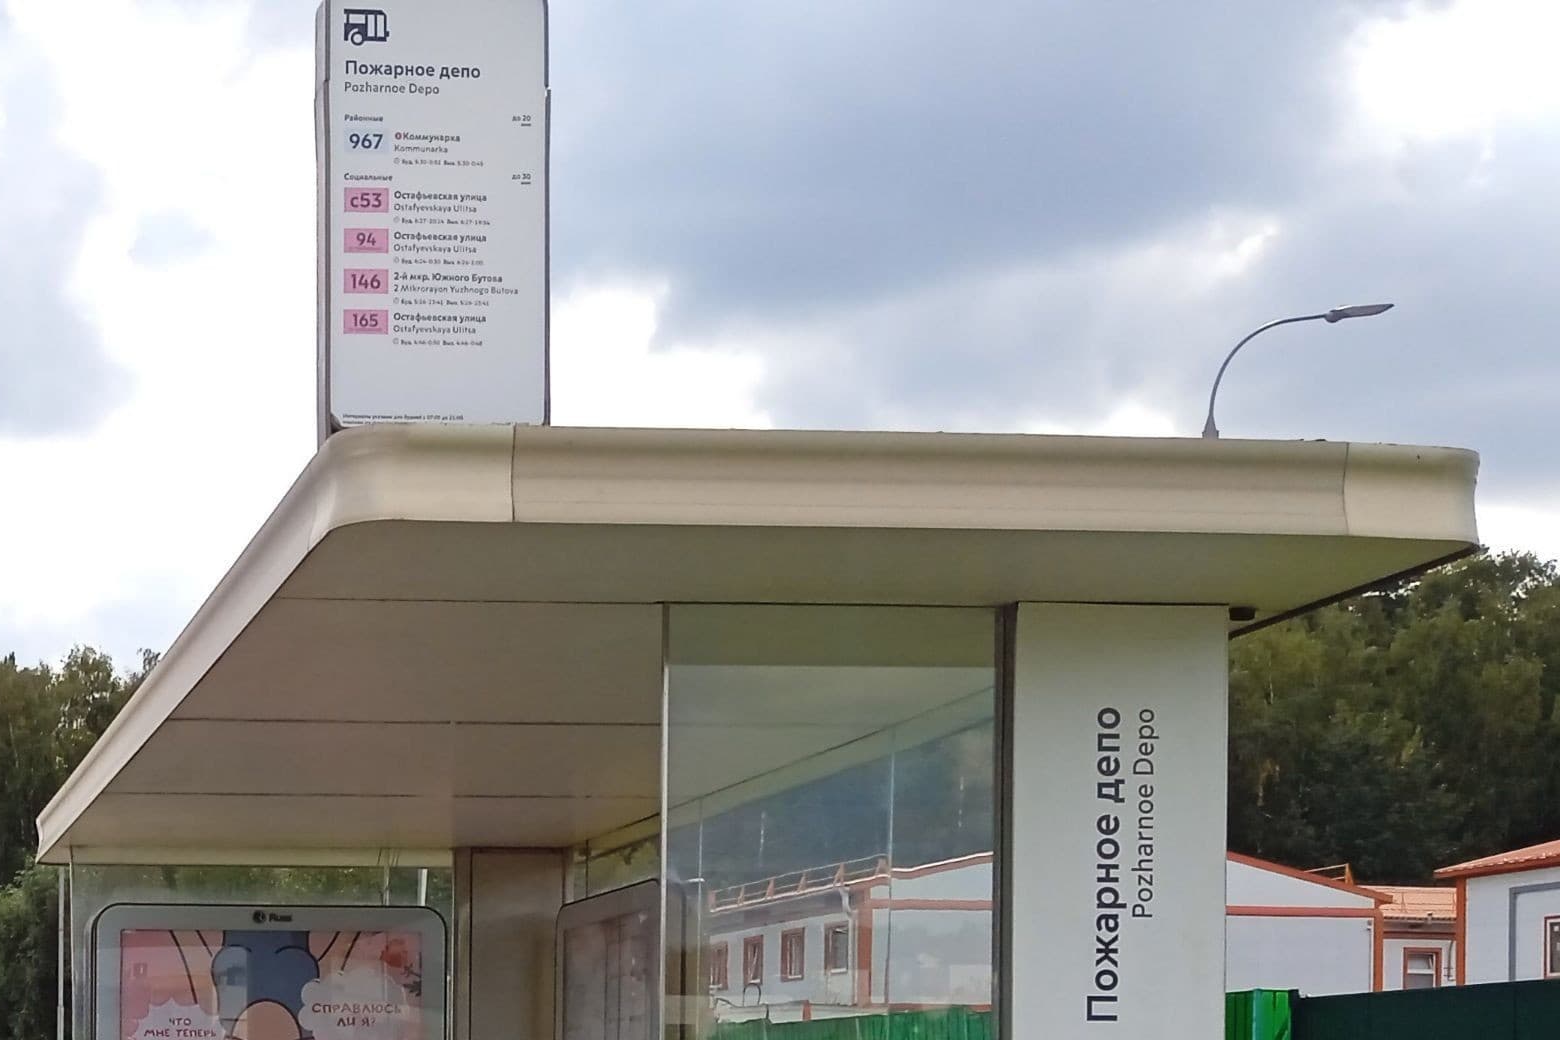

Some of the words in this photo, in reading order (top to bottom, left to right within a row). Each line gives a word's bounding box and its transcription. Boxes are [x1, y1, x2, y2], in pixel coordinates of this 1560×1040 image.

[345, 60, 435, 79] Пожарное
[439, 66, 481, 80] депо
[344, 81, 406, 94] Pozharnoe
[408, 83, 440, 96] Depo
[349, 133, 383, 149] 967
[402, 132, 461, 143] Коммунарка
[394, 145, 448, 153] Kommunarka
[344, 173, 393, 181] Социальные
[394, 190, 458, 201] Остафьевская
[460, 193, 487, 203] улица
[394, 203, 451, 213] Ostafyevskaya
[453, 205, 477, 213] Ulitsa
[356, 232, 376, 246] 94
[394, 231, 458, 242] Остафьевская
[460, 233, 487, 243] улица
[394, 244, 451, 253] Ostafyevskaya
[453, 245, 477, 253] Ulitsa
[351, 274, 381, 289] 146
[393, 272, 408, 280] 2-й
[432, 273, 470, 282] Южного
[472, 273, 503, 283] Бутова
[393, 284, 399, 292] 2
[400, 285, 448, 294] Mikrorayon
[450, 285, 489, 295] Yuzhnogo
[491, 286, 518, 294] Butova
[352, 314, 378, 328] 165
[393, 312, 457, 322] Остафьевская
[459, 315, 486, 324] улица
[393, 325, 451, 334] Ostafyevskaya
[452, 326, 476, 334] Ulitsa
[1133, 708, 1159, 775] Depo
[1096, 707, 1125, 803] депо
[1131, 784, 1154, 918] Pozharnoe
[1086, 814, 1127, 1022] Пожарное
[311, 1003, 401, 1014] СПРАВЛЮСЬ
[169, 1018, 191, 1026] ЧТО
[337, 1016, 355, 1027] ЛИ
[144, 1028, 170, 1037] МНЕ
[176, 1028, 216, 1038] ТЕПЕРЬ
